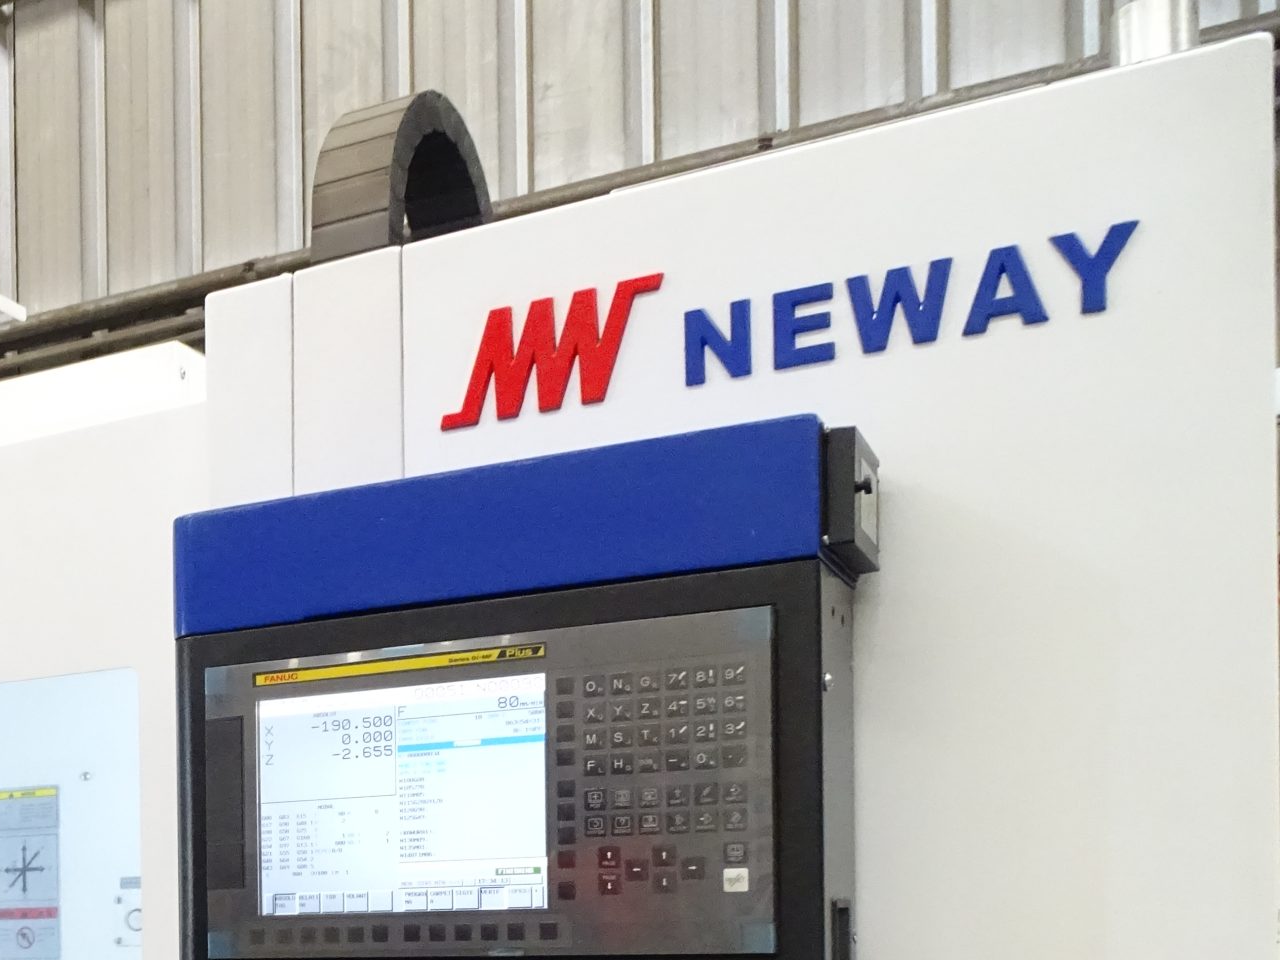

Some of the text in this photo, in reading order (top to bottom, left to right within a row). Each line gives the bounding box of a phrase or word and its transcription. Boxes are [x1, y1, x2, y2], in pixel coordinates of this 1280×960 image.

[683, 220, 1140, 388] NEWAY
[506, 648, 532, 658] Plus
[264, 673, 299, 684] FANUC
[669, 674, 677, 684] 7
[696, 671, 706, 682] 8
[724, 669, 734, 680] 9
[613, 679, 623, 689] N
[640, 676, 650, 687] G
[586, 682, 596, 692] O
[668, 701, 677, 710] 4
[696, 698, 706, 709] 5
[724, 696, 734, 706] 6
[397, 706, 408, 717] F
[497, 696, 519, 709] 80
[614, 706, 623, 716] Y
[641, 704, 650, 714] Z
[587, 708, 596, 718] X
[264, 725, 274, 737] X
[311, 715, 393, 733] -190.500
[696, 726, 706, 736] 2
[725, 724, 734, 734] 3
[614, 732, 623, 742] S
[641, 730, 650, 740] T
[669, 728, 676, 738] 1
[264, 730, 393, 751] Y 0.000
[586, 734, 596, 744] M
[265, 746, 393, 766] Z -2.655
[586, 760, 596, 771] F
[614, 758, 624, 769] H
